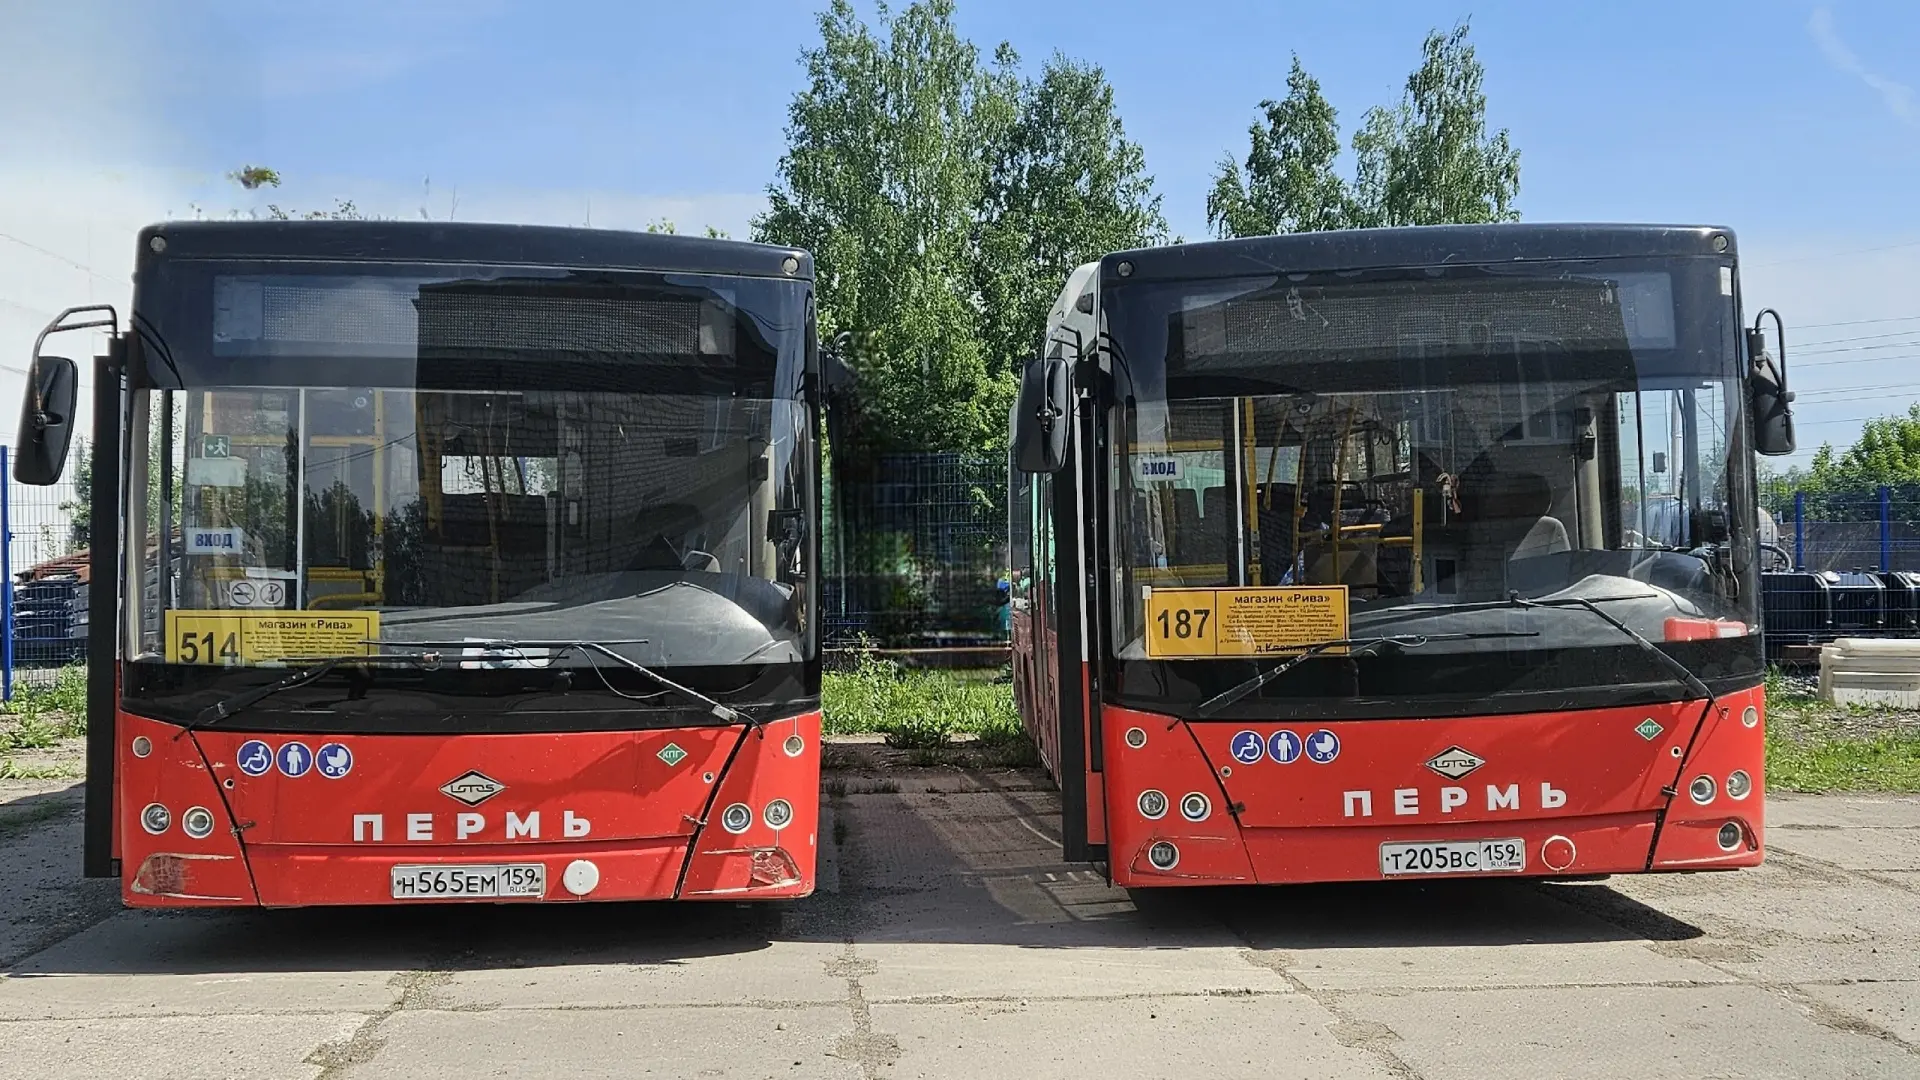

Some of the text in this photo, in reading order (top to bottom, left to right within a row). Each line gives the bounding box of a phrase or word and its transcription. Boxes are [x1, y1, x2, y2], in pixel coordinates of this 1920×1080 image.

[195, 533, 233, 548] ВХОД
[1234, 593, 1331, 604] магазин «Рива»
[258, 619, 353, 629] магазин «Рива»
[1157, 609, 1211, 640] 187
[180, 631, 239, 664] 514
[662, 750, 680, 758] КПГ
[1343, 782, 1567, 817] ПЕРМЬ
[353, 810, 591, 841] ПЕРМЬ
[1390, 844, 1516, 870] Т205ВС 159
[402, 868, 535, 894] Н565ЕМ 159
